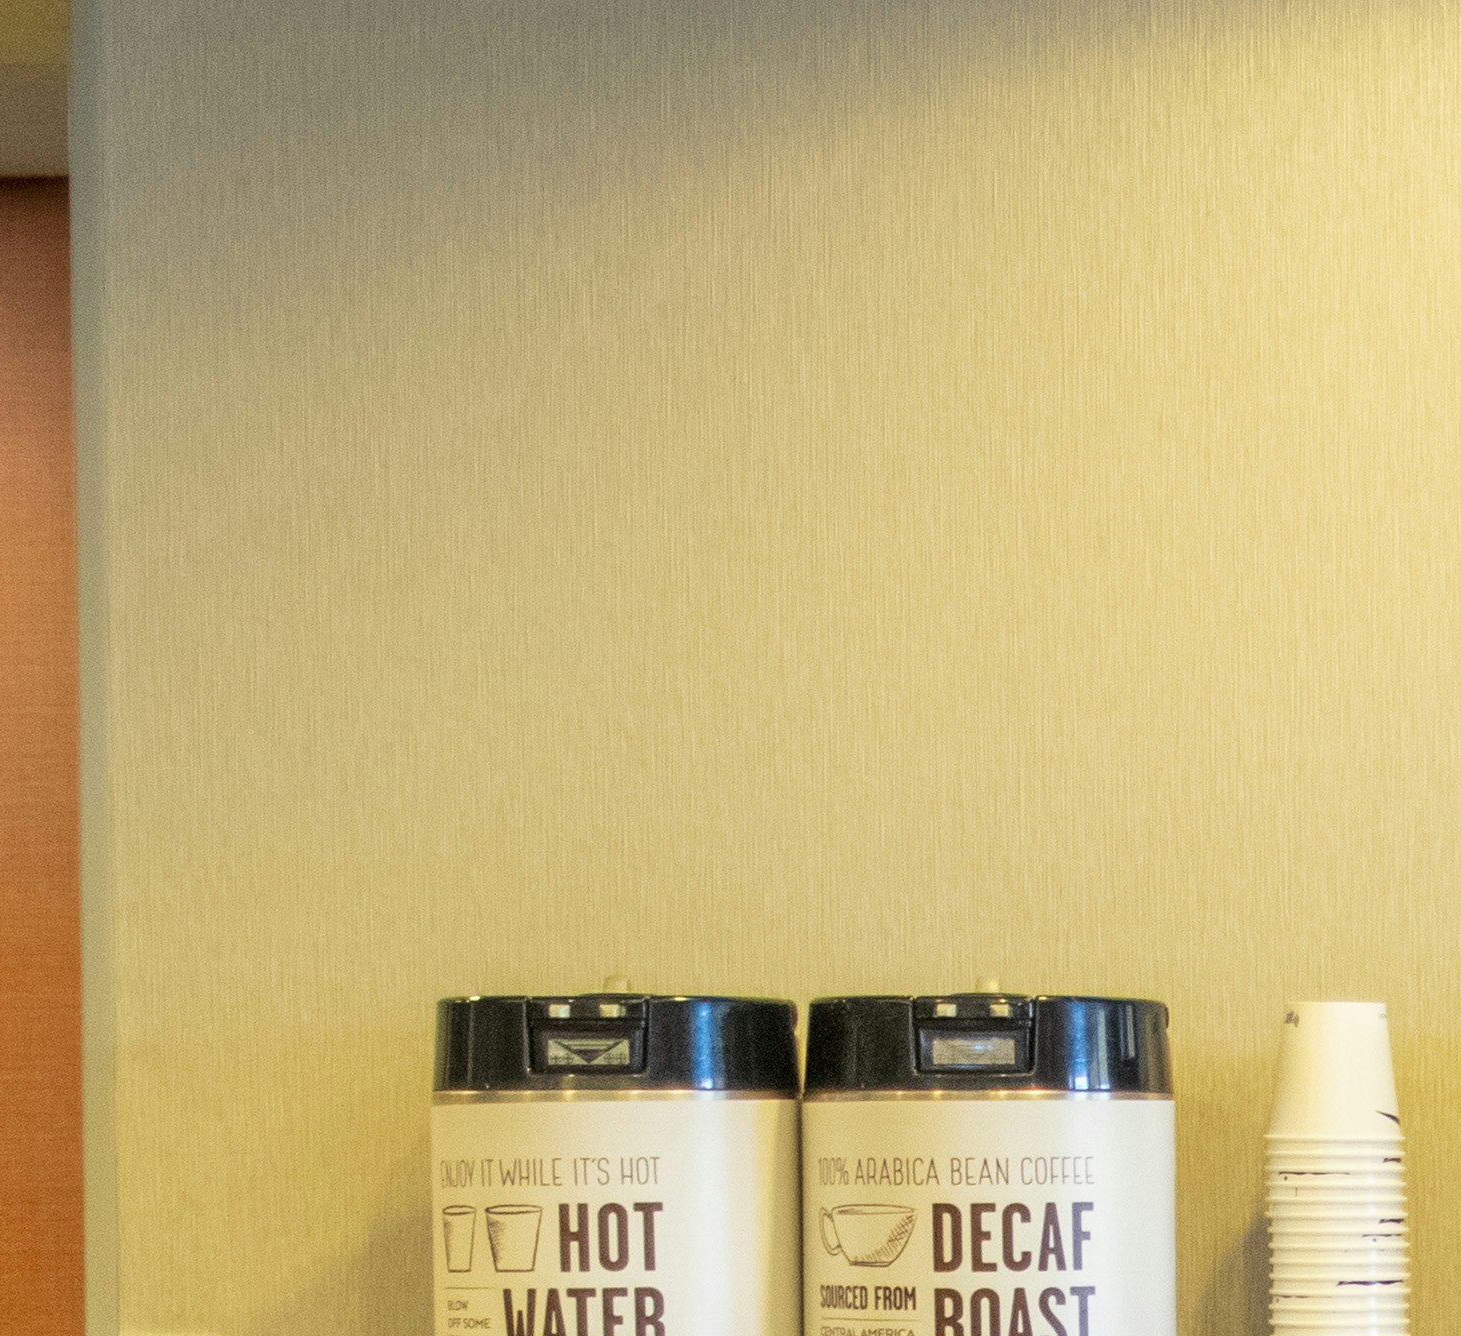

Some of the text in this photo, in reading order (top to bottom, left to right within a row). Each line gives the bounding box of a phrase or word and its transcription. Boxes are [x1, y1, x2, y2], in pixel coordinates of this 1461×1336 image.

[480, 1159, 494, 1187] IT
[499, 1157, 563, 1187] WHILE
[573, 1157, 610, 1186] IT'S
[620, 1156, 661, 1186] HOT
[817, 1156, 1096, 1187] 100% ARABICA BEAN COFFEE
[557, 1202, 664, 1272] HOT
[932, 1201, 1095, 1272] DECAF
[819, 1284, 917, 1311] SOURCED FROM
[464, 1318, 491, 1329] SOME
